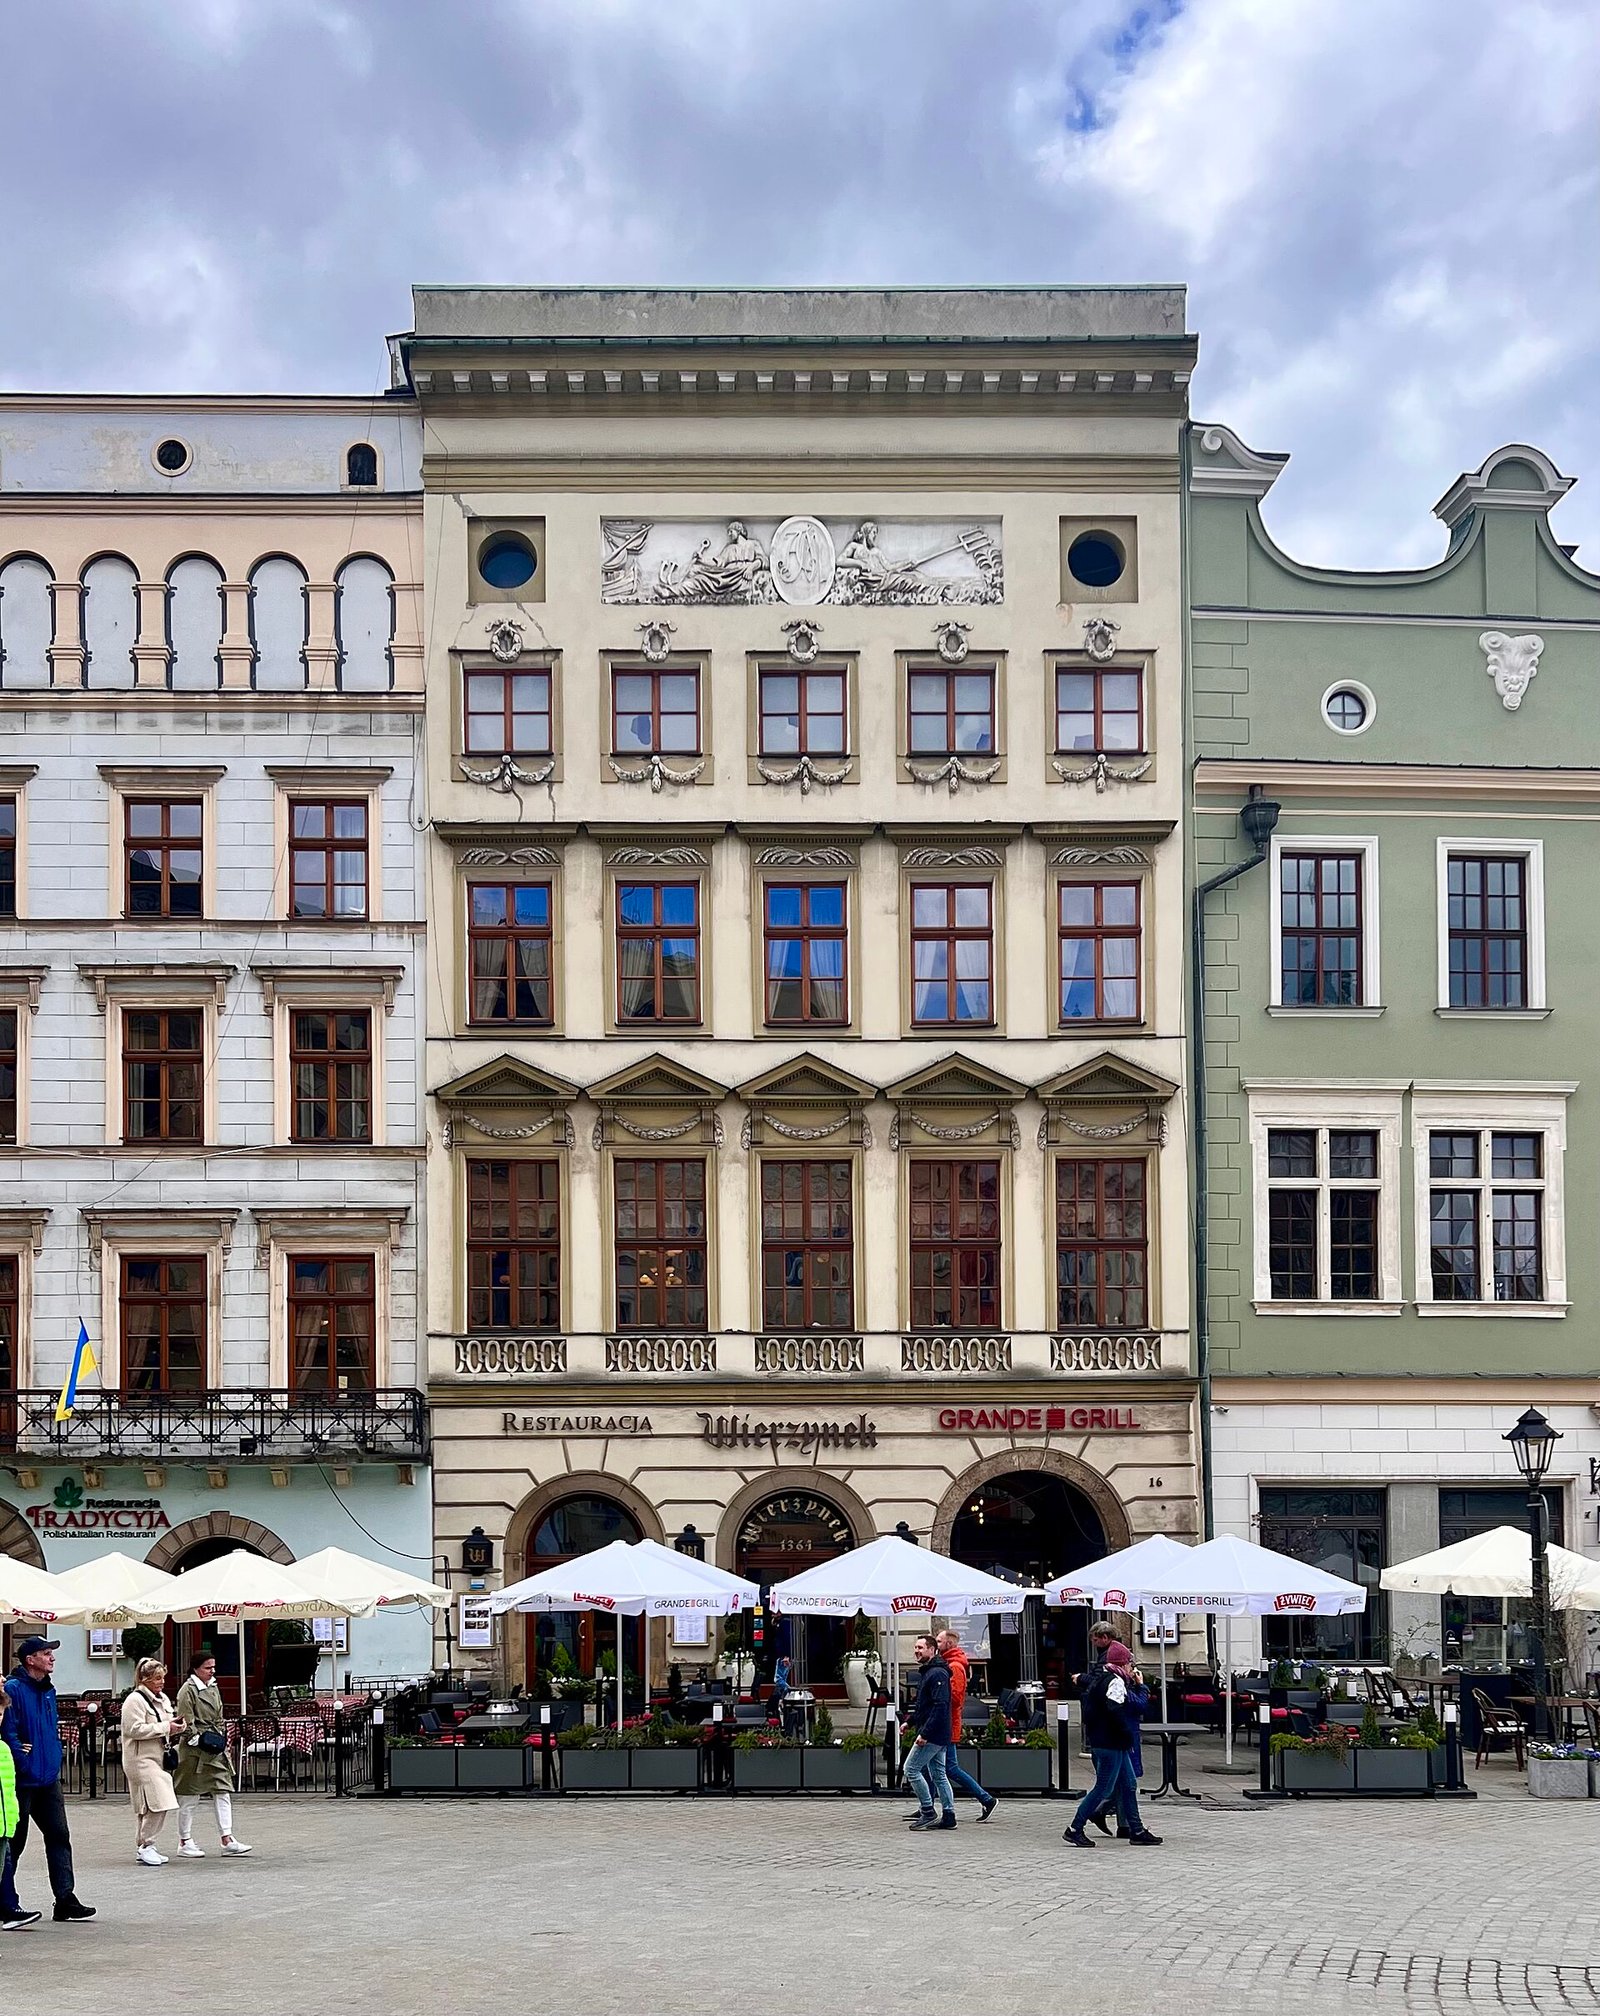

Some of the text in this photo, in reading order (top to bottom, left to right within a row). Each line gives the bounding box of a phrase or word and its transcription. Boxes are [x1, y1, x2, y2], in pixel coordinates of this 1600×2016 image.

[502, 1412, 653, 1434] RESTAURACJA
[939, 1408, 1141, 1430] GRANDE GRILL
[696, 1411, 878, 1455] Wierzynek
[1149, 1477, 1163, 1488] 16
[85, 1498, 161, 1509] Restauracja
[26, 1502, 172, 1530] TRADYCYJA
[739, 1497, 849, 1543] Wierzynek
[106, 1530, 156, 1539] Restaurant
[654, 1599, 690, 1609] GRANDE
[696, 1598, 720, 1608] GRILL
[786, 1597, 819, 1607] GRANDE
[825, 1597, 850, 1608] GRILL
[897, 1596, 932, 1608] ŻYWIEC
[1152, 1596, 1235, 1606] GRANDE GRILL
[1279, 1594, 1313, 1606] ŻYWIEC
